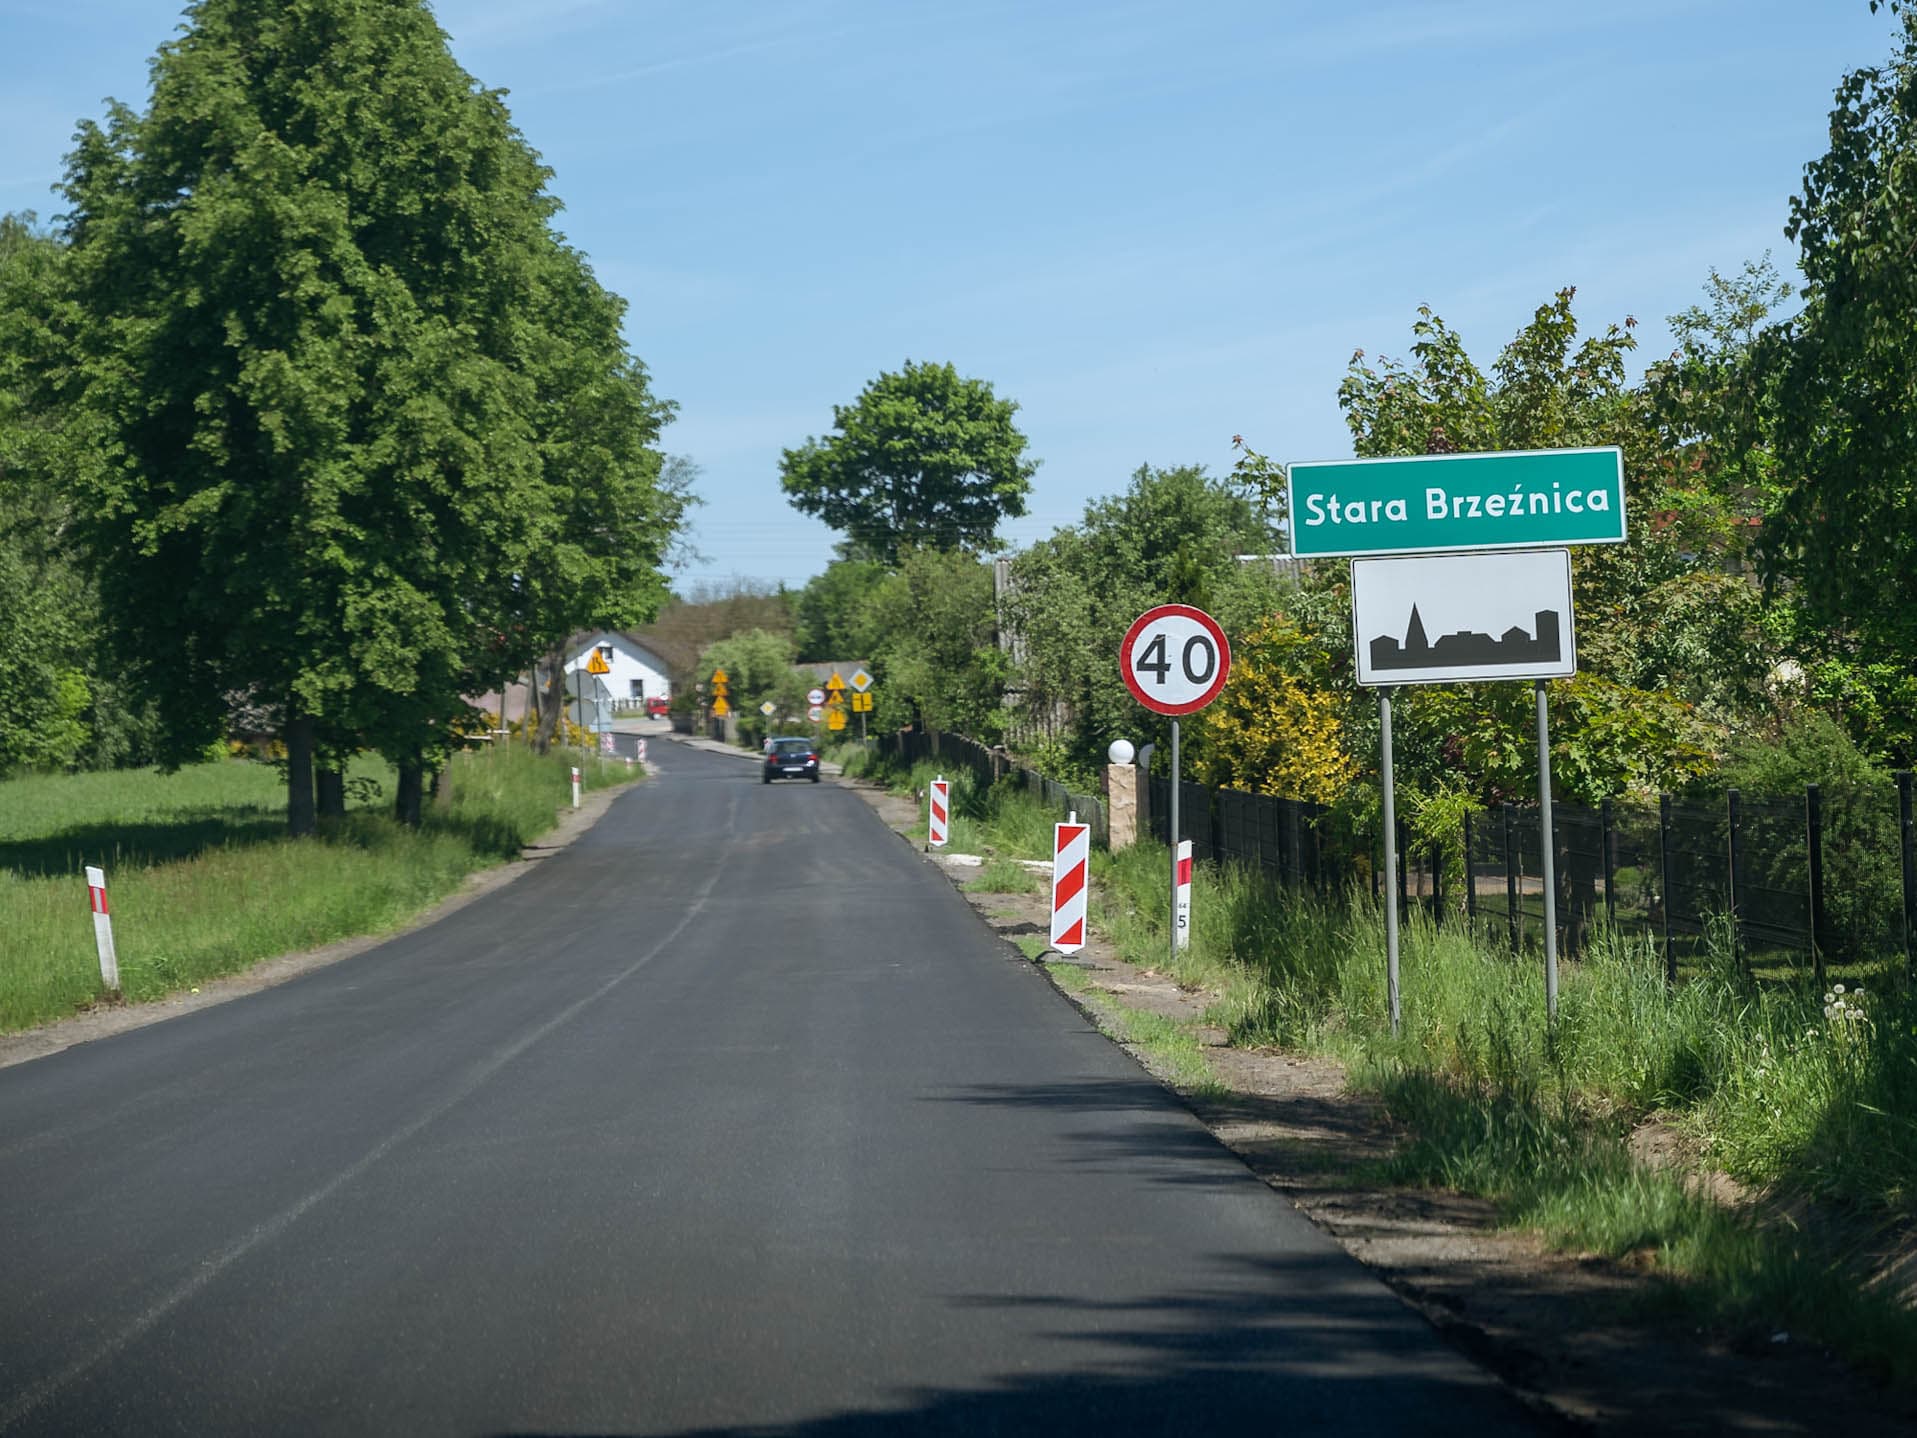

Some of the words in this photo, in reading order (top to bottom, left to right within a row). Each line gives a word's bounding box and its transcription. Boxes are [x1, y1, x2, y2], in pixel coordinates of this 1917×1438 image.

[1304, 493, 1408, 527] Stara
[1425, 482, 1610, 520] Brzeźnica
[1136, 634, 1216, 685] 40
[1177, 915, 1187, 929] 5
